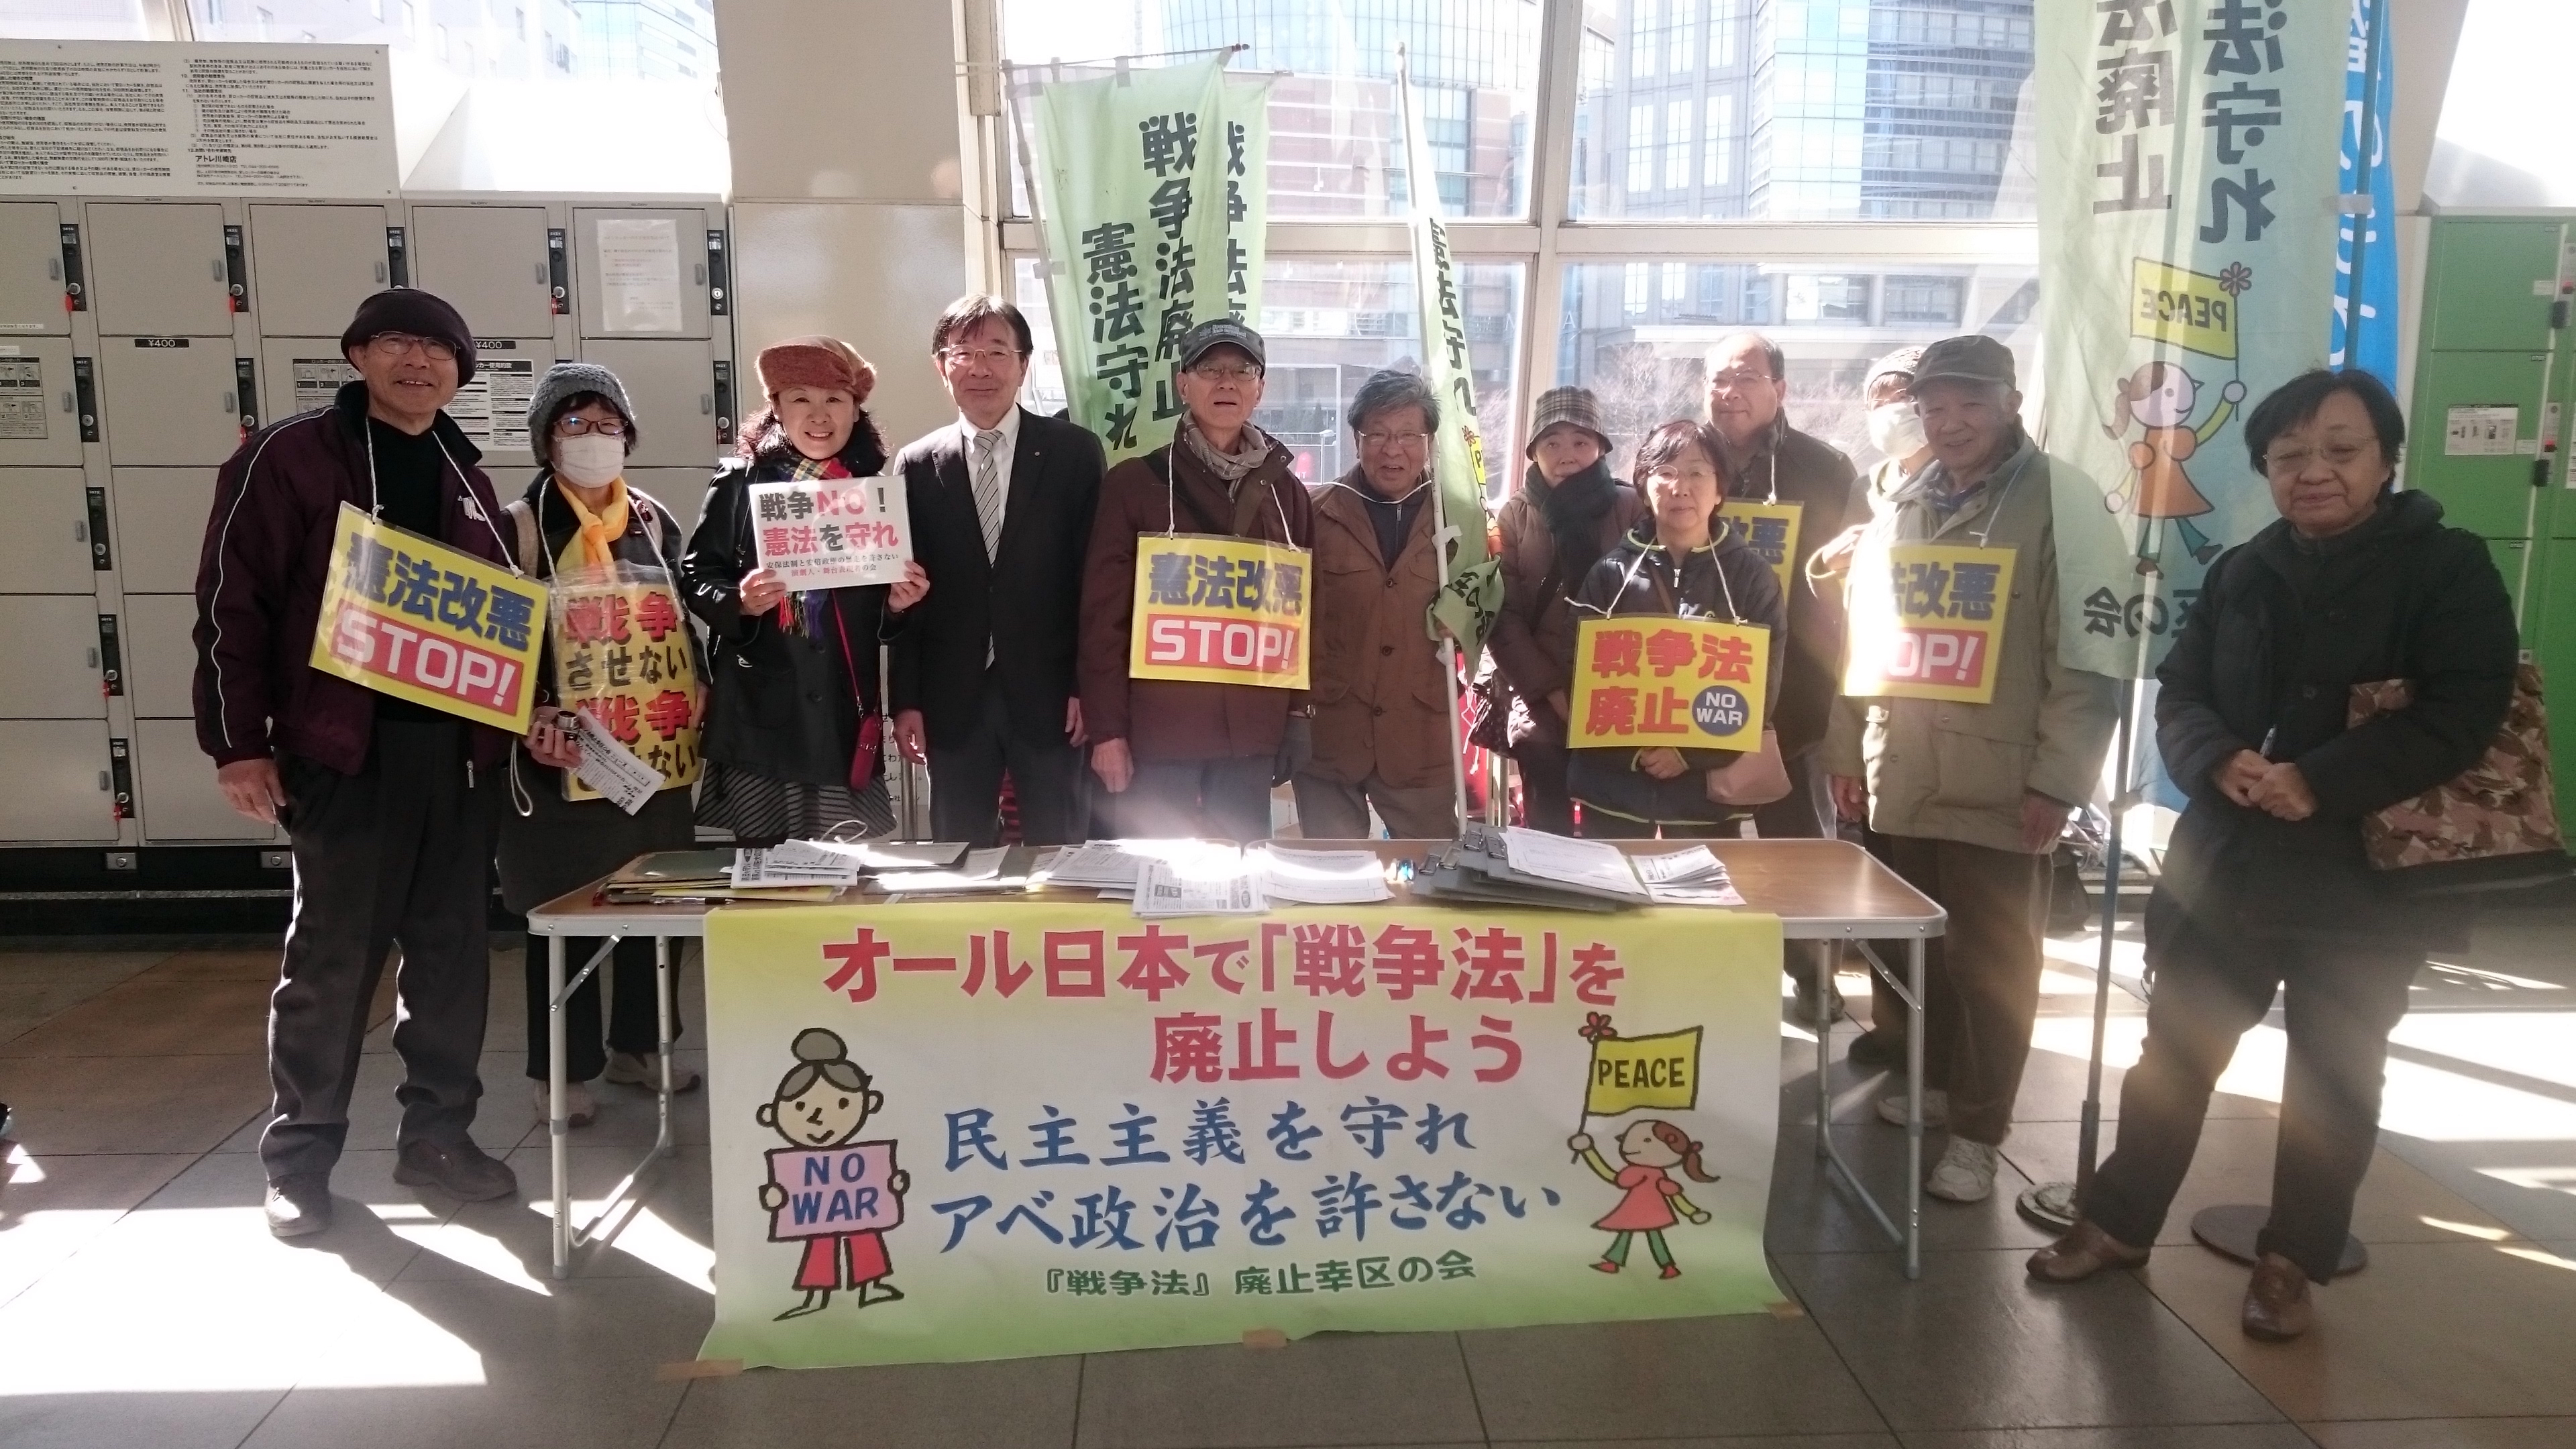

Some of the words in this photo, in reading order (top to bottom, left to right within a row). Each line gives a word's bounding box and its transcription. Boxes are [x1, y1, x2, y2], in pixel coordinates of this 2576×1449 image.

[195, 155, 237, 163] アトレ川崎店
[476, 341, 502, 349] ¥400
[1081, 222, 1149, 451] 憲法守れ
[763, 521, 899, 557] 憲法を守れ
[342, 531, 535, 653] 憲法改悪
[1148, 552, 1303, 616] 憲法改悪
[565, 591, 678, 649] 戦争
[1150, 619, 1295, 670] STOP!
[336, 610, 517, 708] STOP!
[566, 645, 688, 690] させない
[1592, 629, 1753, 684] 戦争法
[1585, 685, 1689, 737] 廃止
[1697, 708, 1743, 727] WAR
[1705, 692, 1736, 708] NO
[822, 924, 1625, 1006] オール日本で「戦争法」を
[1150, 1008, 1522, 1083] 廃止しよう
[1597, 1057, 1686, 1089] PEACE
[945, 1096, 1476, 1172] 民主主義を守れ
[804, 1152, 865, 1187] NO
[792, 1186, 879, 1226] WAR
[930, 1171, 1562, 1254] アベ政治を許さない
